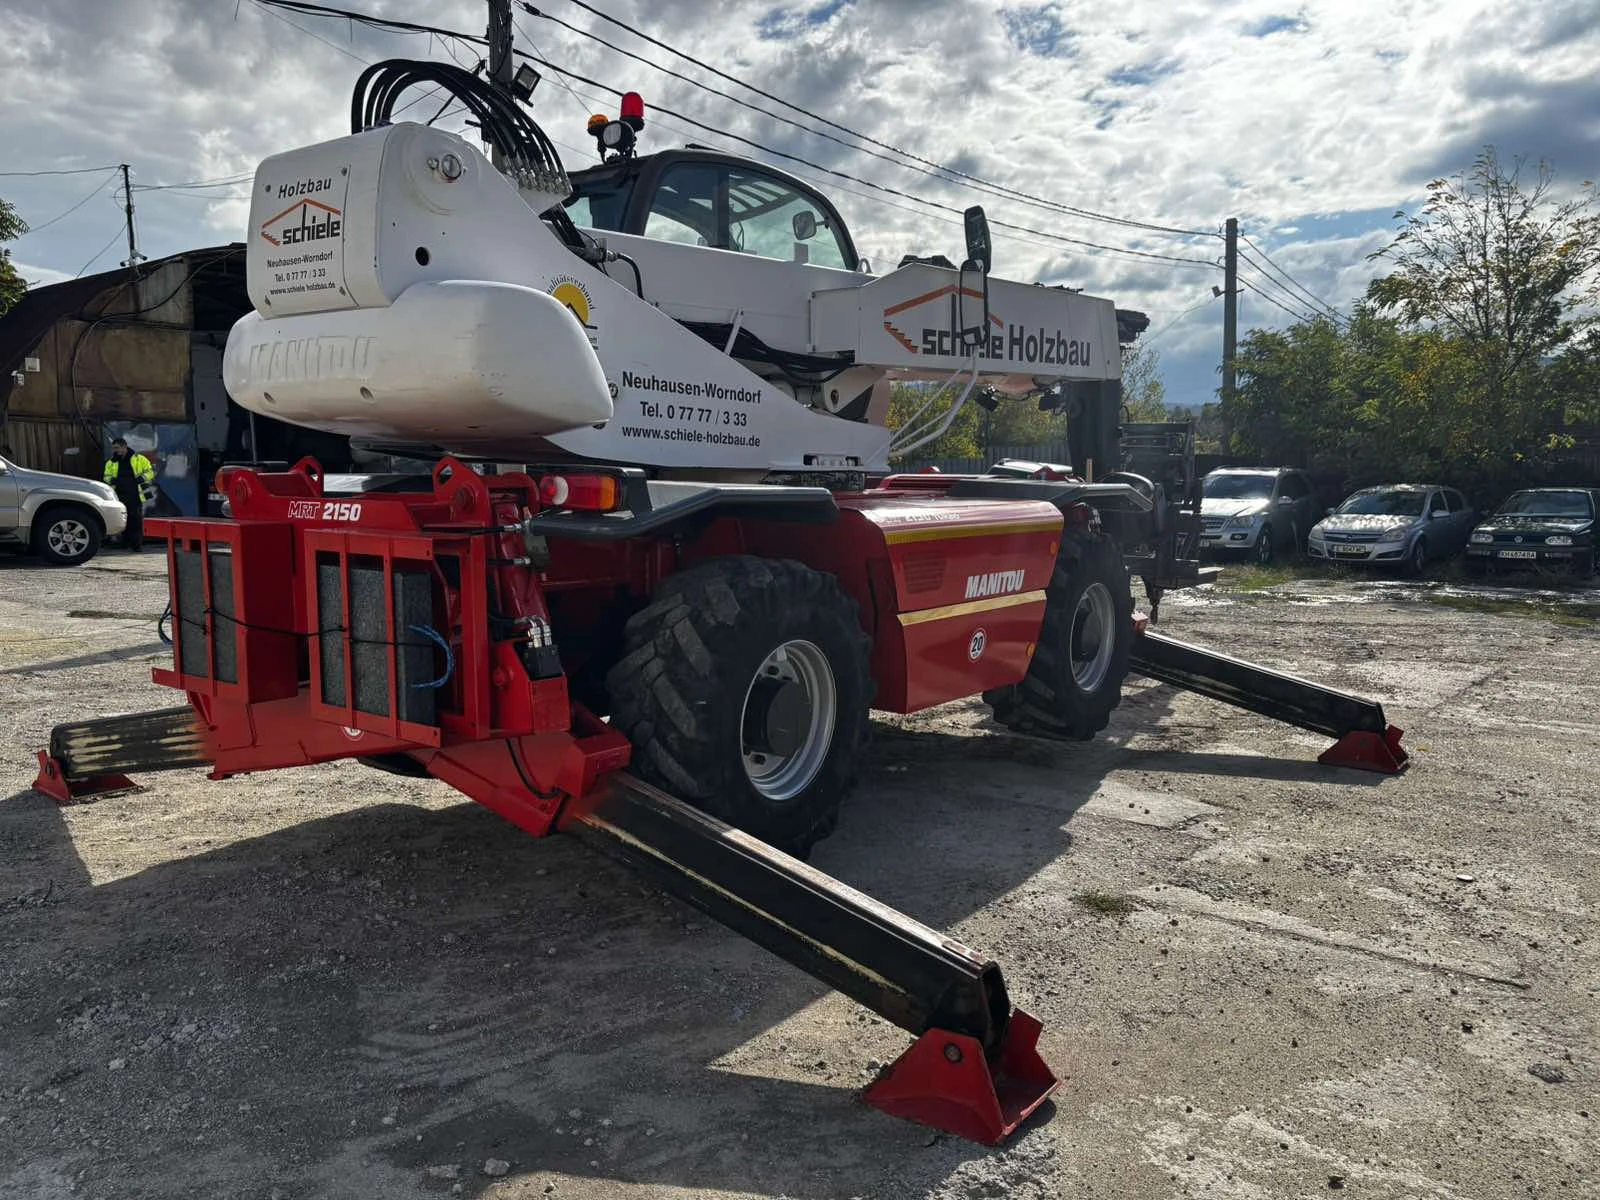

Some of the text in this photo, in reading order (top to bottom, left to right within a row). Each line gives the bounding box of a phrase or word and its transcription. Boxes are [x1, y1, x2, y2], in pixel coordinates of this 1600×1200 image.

[278, 178, 332, 199] Holzbau
[282, 203, 341, 245] schiele
[266, 250, 333, 268] Neuhausen-Worndorf
[275, 273, 285, 282] Tel.
[545, 274, 597, 310] ualitätsverbund
[1008, 324, 1091, 367] Holzbau
[622, 371, 761, 404] Neuhausen-Worndorf
[640, 401, 663, 418] Tel.
[667, 405, 675, 419] 0
[679, 406, 693, 421] 77
[698, 408, 712, 423] 77
[723, 411, 730, 425] 3
[734, 412, 747, 427] 33
[287, 500, 362, 521] MRT 2150
[965, 569, 1025, 599] MANITOU
[972, 635, 984, 652] 20
